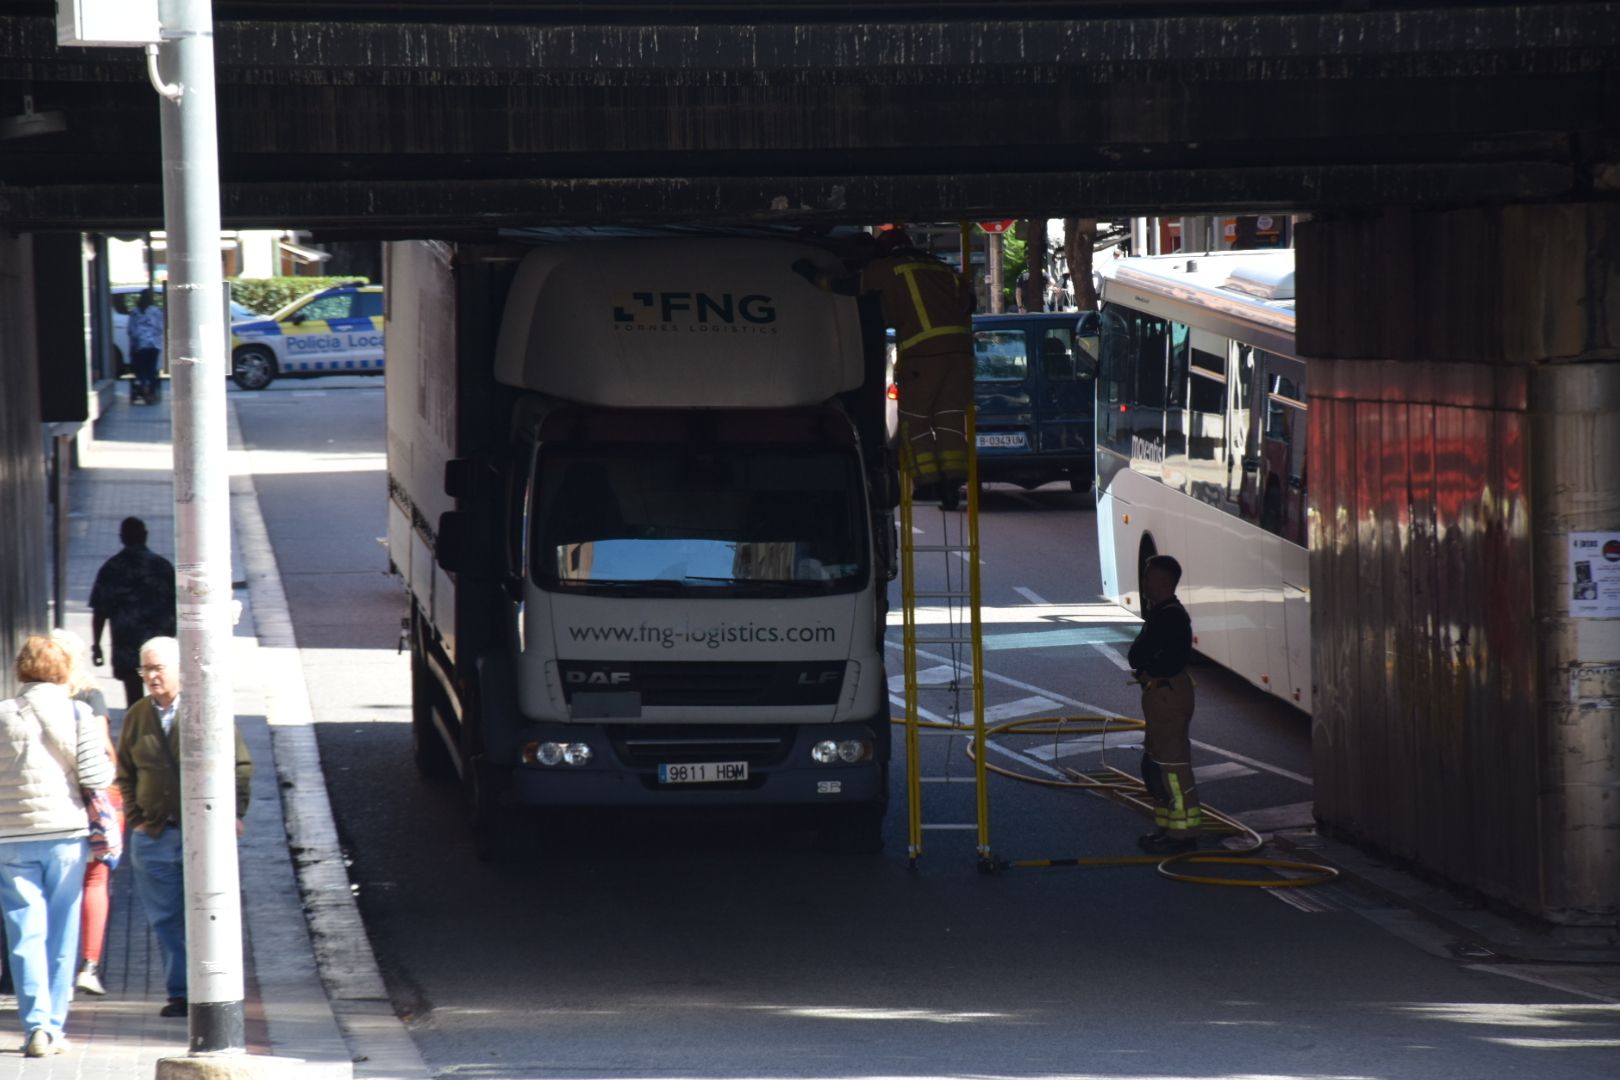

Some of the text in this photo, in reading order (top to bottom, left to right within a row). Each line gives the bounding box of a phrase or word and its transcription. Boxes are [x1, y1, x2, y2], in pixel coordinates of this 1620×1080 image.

[661, 292, 776, 324] FNG
[689, 324, 778, 335] LOGISTICS
[348, 333, 385, 347] Loca
[566, 671, 631, 685] DAF
[798, 671, 841, 684] LF
[669, 764, 746, 781] 9811 HBM
